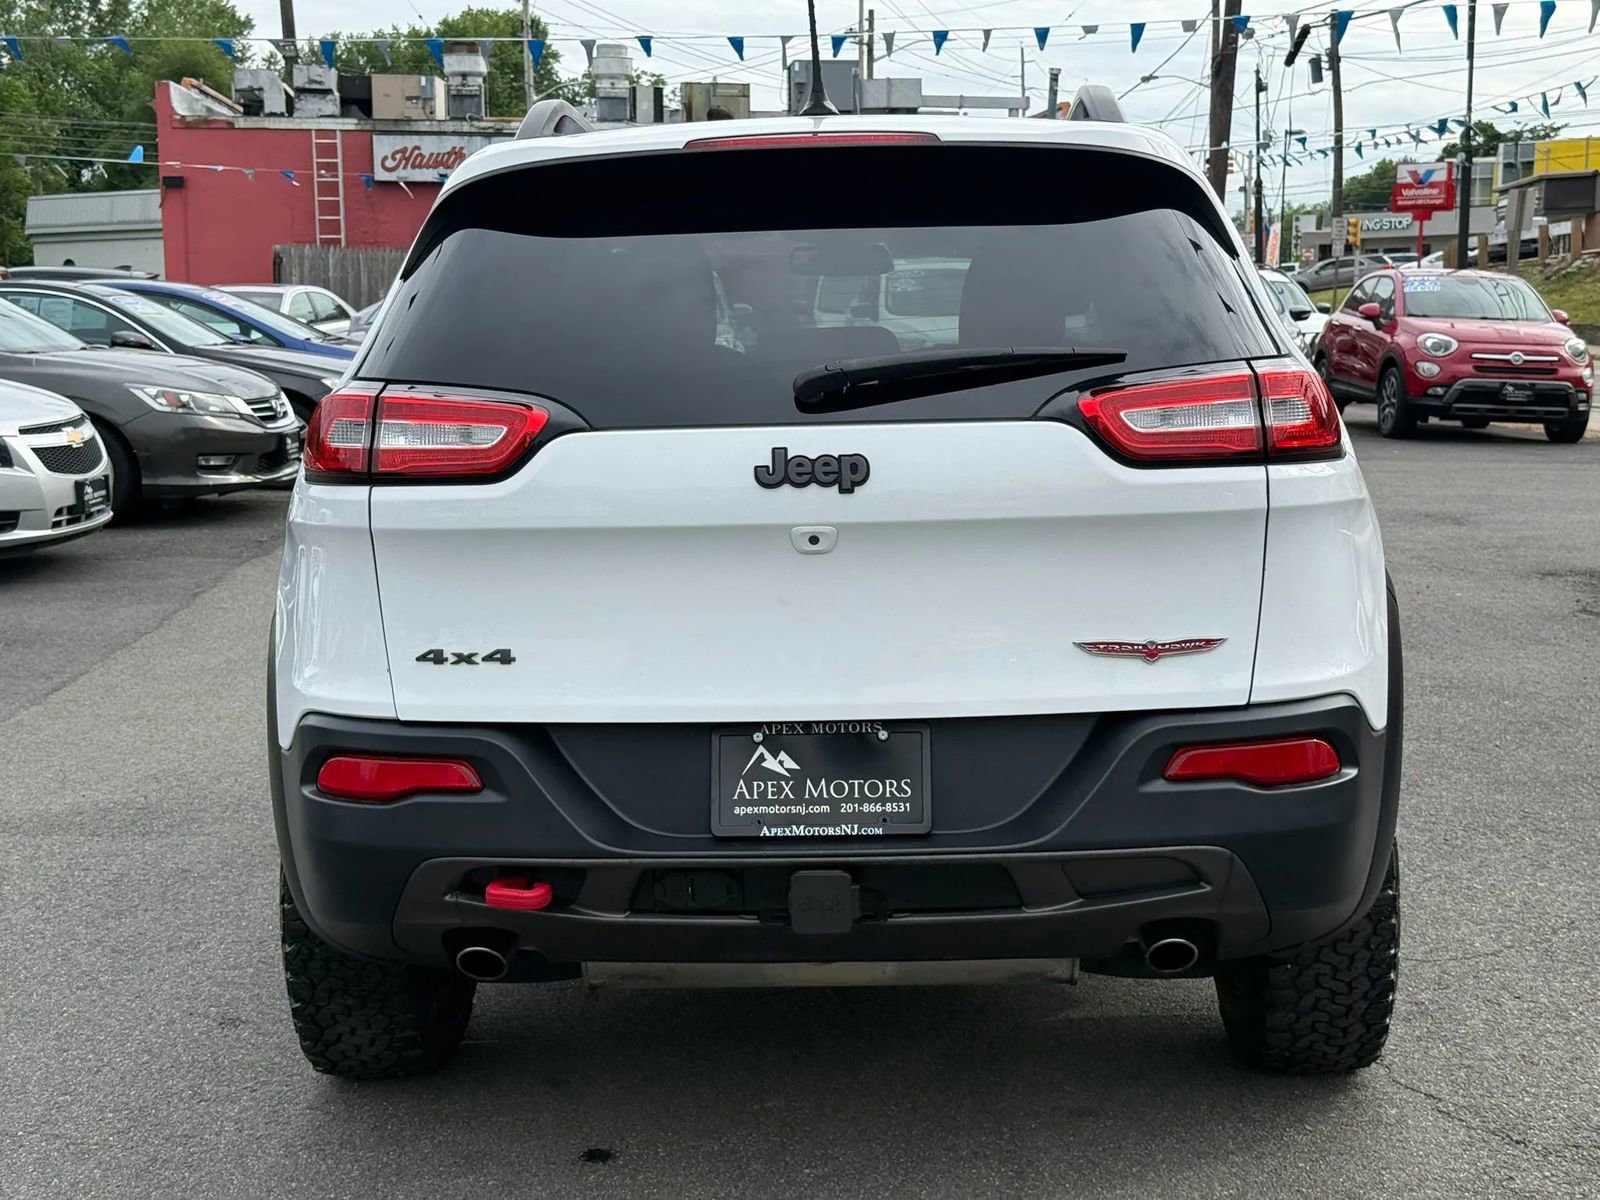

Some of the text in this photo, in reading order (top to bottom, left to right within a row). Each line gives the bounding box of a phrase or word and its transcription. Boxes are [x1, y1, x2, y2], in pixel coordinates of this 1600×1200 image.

[1401, 188, 1440, 197] Valvoline
[754, 447, 870, 495] Jeep
[415, 648, 517, 665] 4x4
[760, 722, 883, 735] APEX MOTORS
[732, 778, 912, 800] APEX MOTORS
[734, 802, 911, 816] apexmotorsnj.com 201-866-8531
